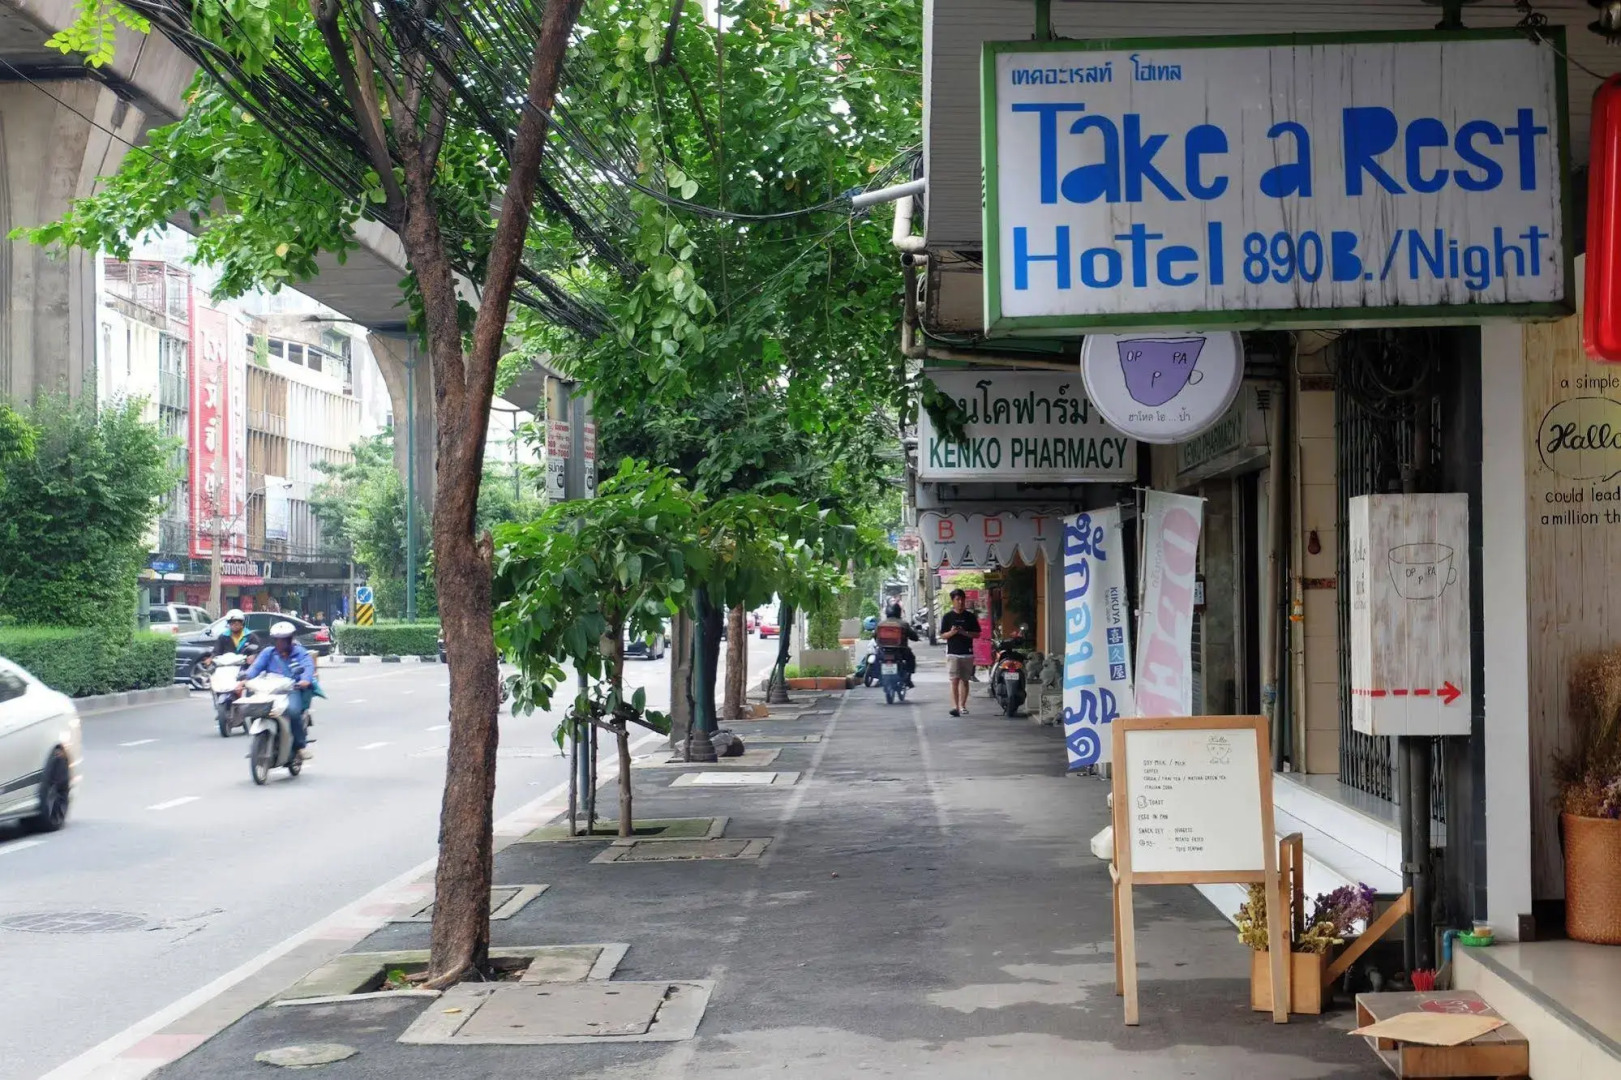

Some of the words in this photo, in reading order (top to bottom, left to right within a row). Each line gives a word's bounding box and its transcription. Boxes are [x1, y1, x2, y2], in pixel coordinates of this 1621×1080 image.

[1011, 102, 1229, 204] Take
[1260, 121, 1311, 198] a
[1342, 106, 1548, 195] Rest
[1013, 221, 1224, 290] Hotel
[1127, 350, 1142, 362] OP
[1172, 351, 1187, 364] PA
[1560, 378, 1569, 388] a
[1576, 373, 1620, 394] simple
[929, 437, 1001, 468] KENKO
[1010, 437, 1128, 469] PHARMACY
[1545, 487, 1584, 503] could
[1110, 585, 1121, 625] KIKUYA
